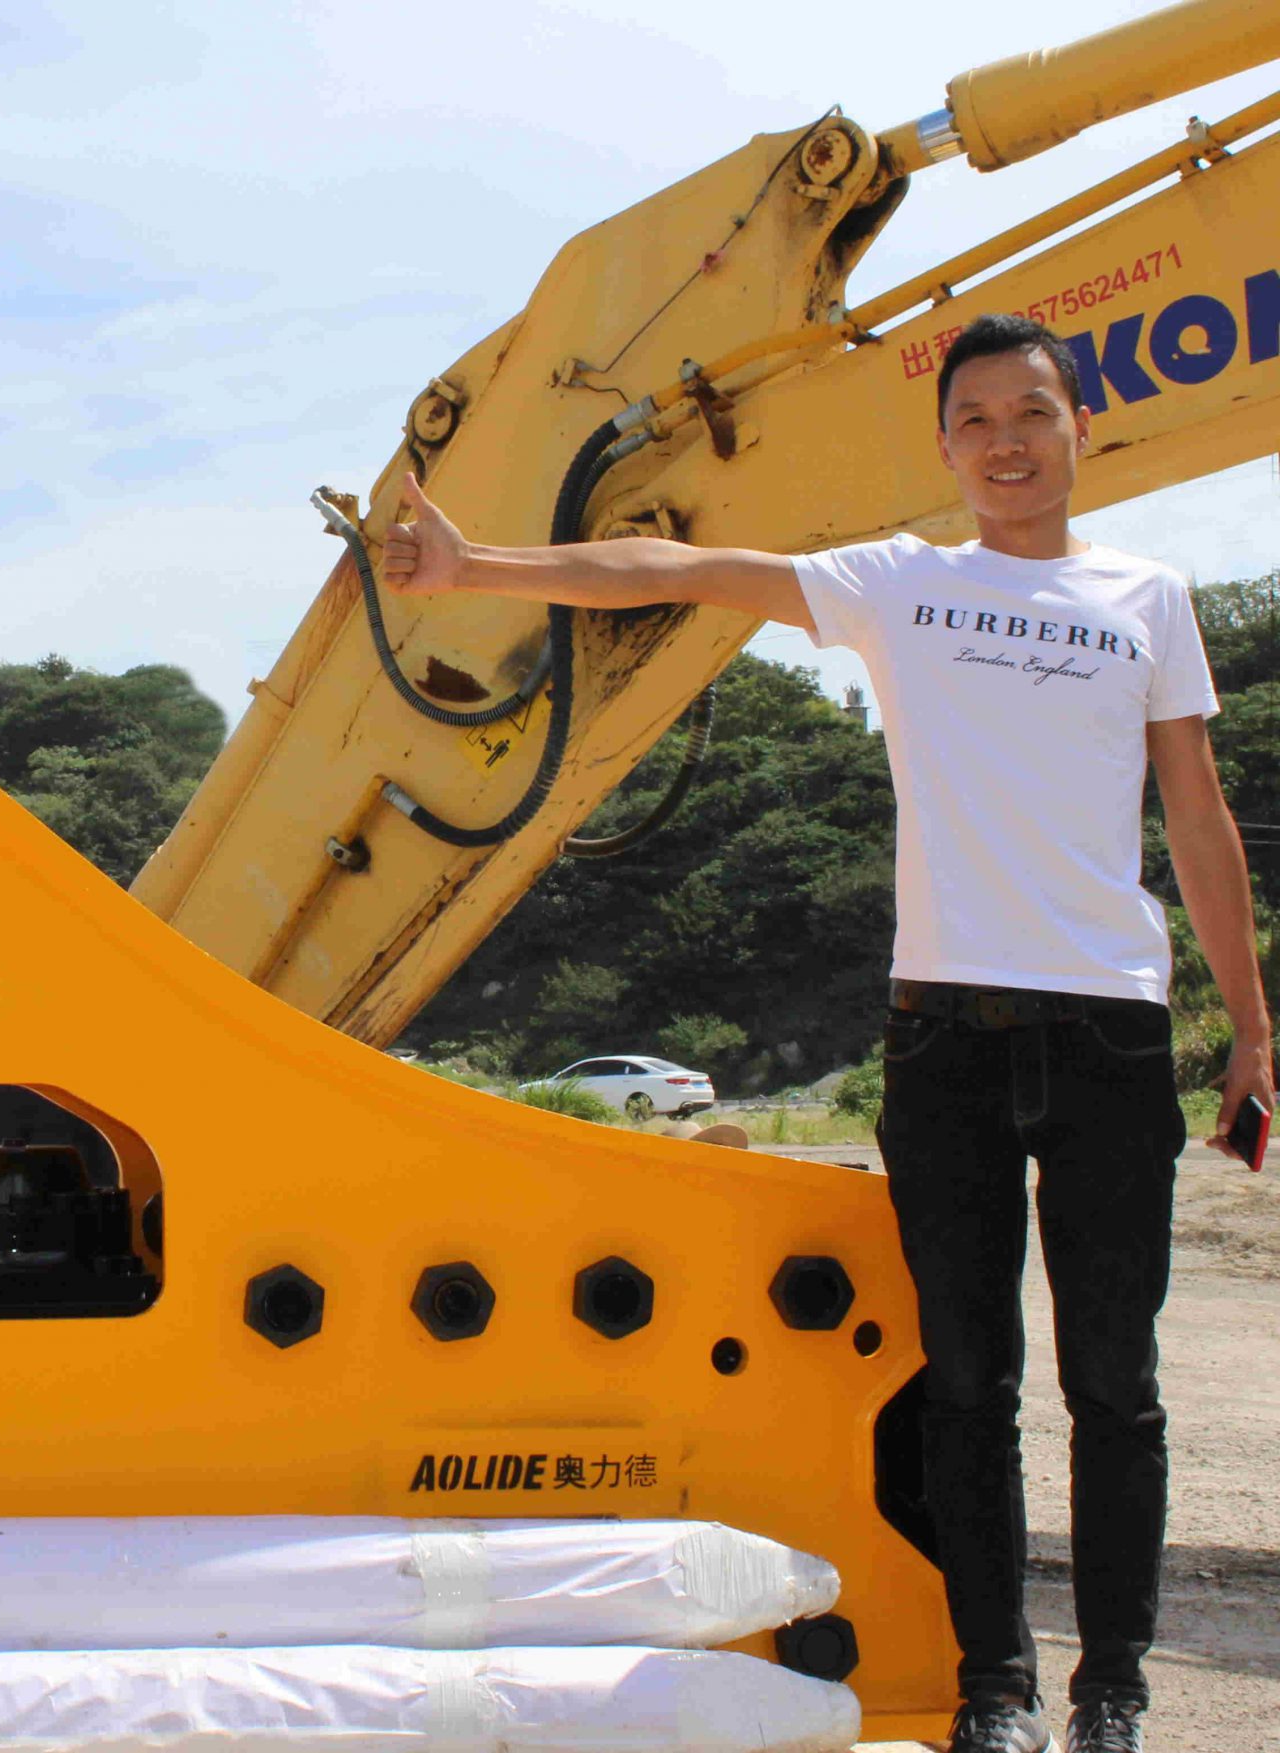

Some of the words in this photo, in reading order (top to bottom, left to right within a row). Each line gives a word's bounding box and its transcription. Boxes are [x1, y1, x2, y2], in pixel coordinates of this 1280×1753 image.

[1011, 243, 1183, 326] 575624471
[912, 604, 1141, 662] BURBERRY
[1022, 655, 1100, 686] England
[408, 1454, 548, 1492] AOLIDE
[553, 1453, 658, 1490] 奥力德
